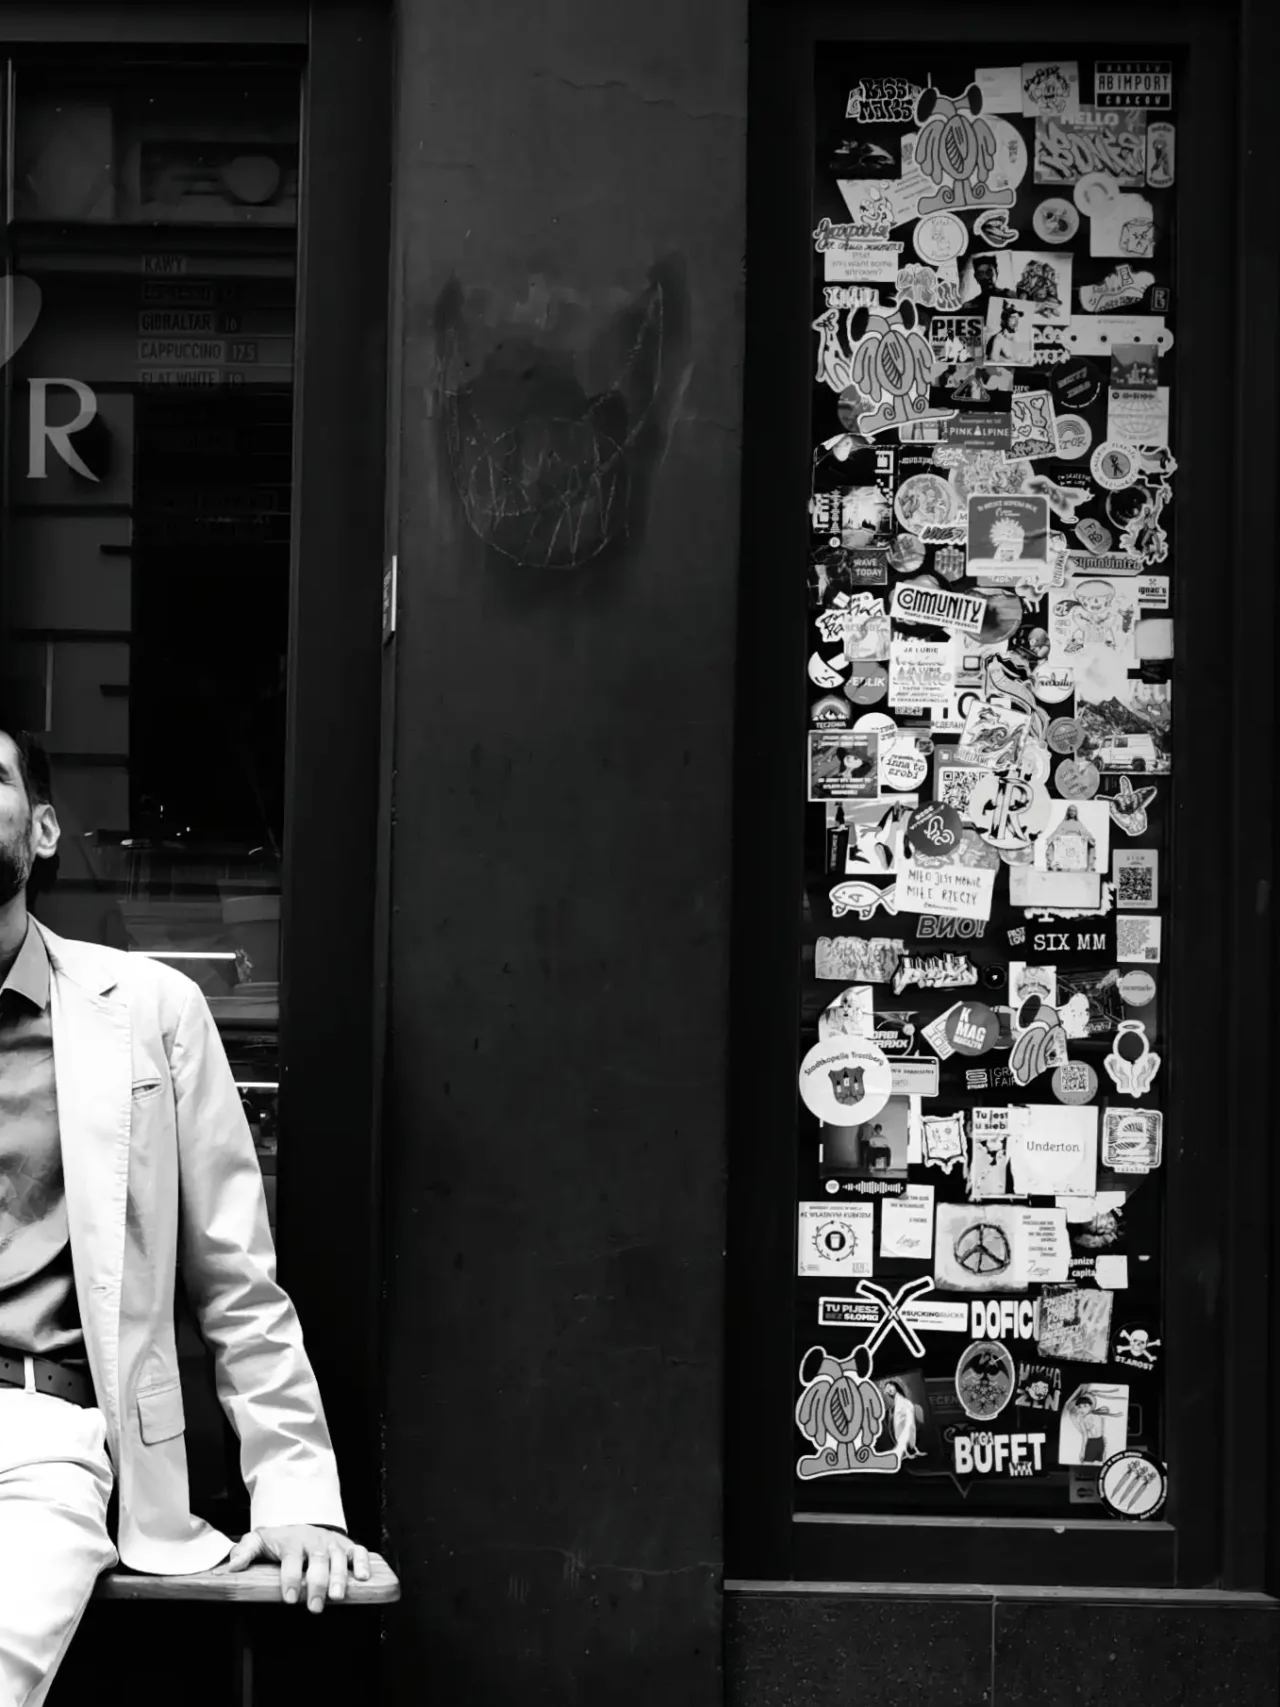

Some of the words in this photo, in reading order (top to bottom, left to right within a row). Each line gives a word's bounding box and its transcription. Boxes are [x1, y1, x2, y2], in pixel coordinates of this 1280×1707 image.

[141, 312, 211, 331] GIBRALTAR
[141, 342, 222, 360] CAPPUCCINO
[949, 426, 974, 436] PINK
[855, 568, 883, 577] TODAY
[886, 759, 910, 769] inna
[913, 762, 925, 771] to
[1033, 933, 1070, 951] SIX
[1077, 933, 1106, 950] MM
[958, 1006, 972, 1022] K
[955, 1021, 987, 1044] MAG
[975, 1110, 988, 1119] Tu
[1026, 1141, 1080, 1152] Underton
[825, 1303, 840, 1312] TU
[842, 1304, 879, 1314] PIJESZ
[843, 1313, 879, 1322] SŁOMKI
